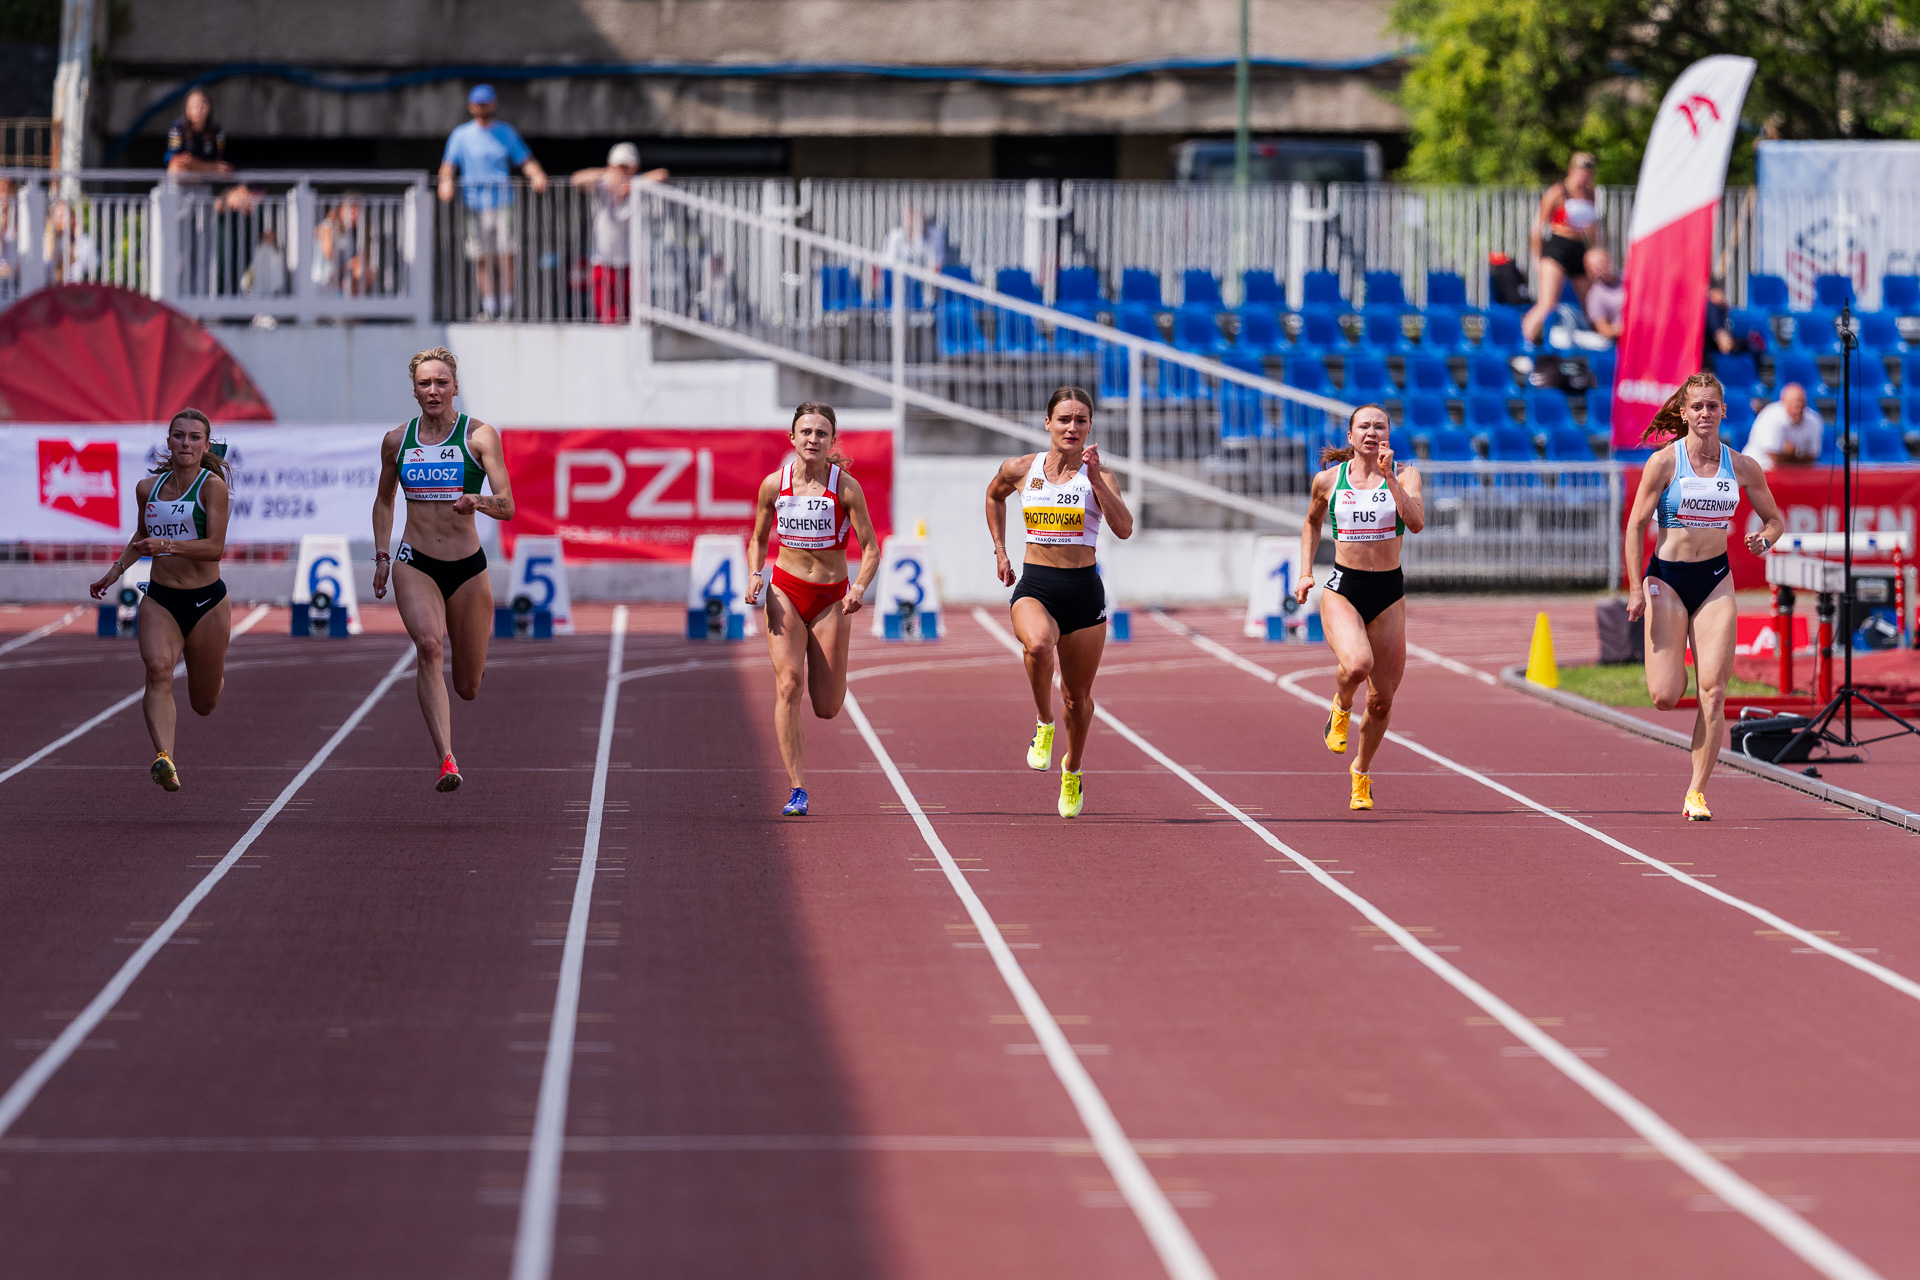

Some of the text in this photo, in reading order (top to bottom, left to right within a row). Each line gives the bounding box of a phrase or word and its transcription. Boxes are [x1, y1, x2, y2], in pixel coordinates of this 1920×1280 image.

[440, 448, 455, 460] 64
[406, 468, 458, 481] GAJOSZ
[1716, 481, 1730, 492] 95
[1056, 494, 1080, 505] 289
[1371, 492, 1387, 502] 63
[171, 504, 185, 515] 74
[807, 500, 828, 511] 175
[1681, 498, 1738, 512] MOCZERNIUK
[778, 516, 832, 531] SUCHENEK
[1024, 513, 1082, 525] PIOTROWSKA
[1353, 511, 1376, 523] FUS
[148, 522, 190, 538] POJĘTA
[399, 547, 410, 561] 5
[309, 557, 341, 607] 6
[523, 557, 555, 611] 5
[702, 558, 737, 608] 4
[894, 558, 924, 608] 3
[1268, 558, 1291, 598] 1
[1326, 570, 1338, 588] 2
